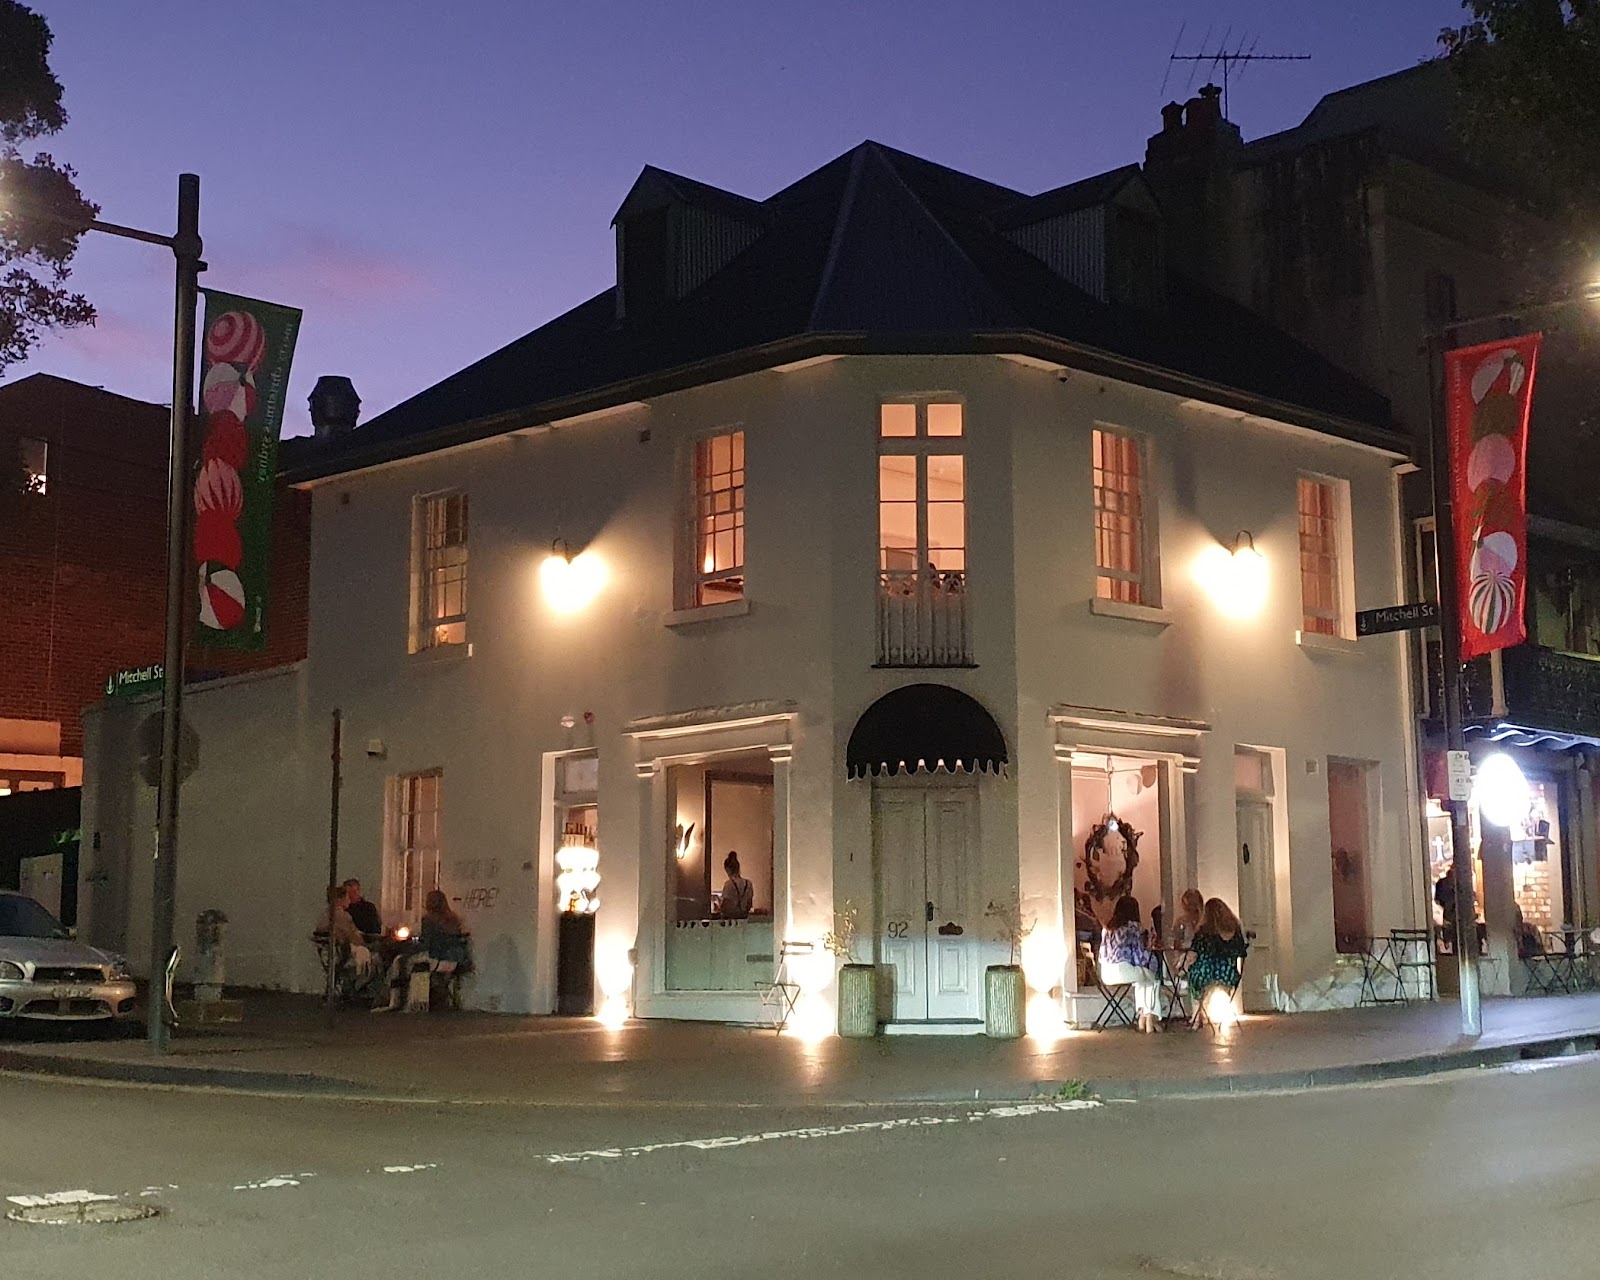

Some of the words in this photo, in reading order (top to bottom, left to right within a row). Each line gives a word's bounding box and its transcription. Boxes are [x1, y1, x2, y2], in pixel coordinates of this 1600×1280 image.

[1376, 607, 1419, 623] Mitchell
[119, 667, 151, 684] Mitchell
[888, 921, 908, 938] 92
